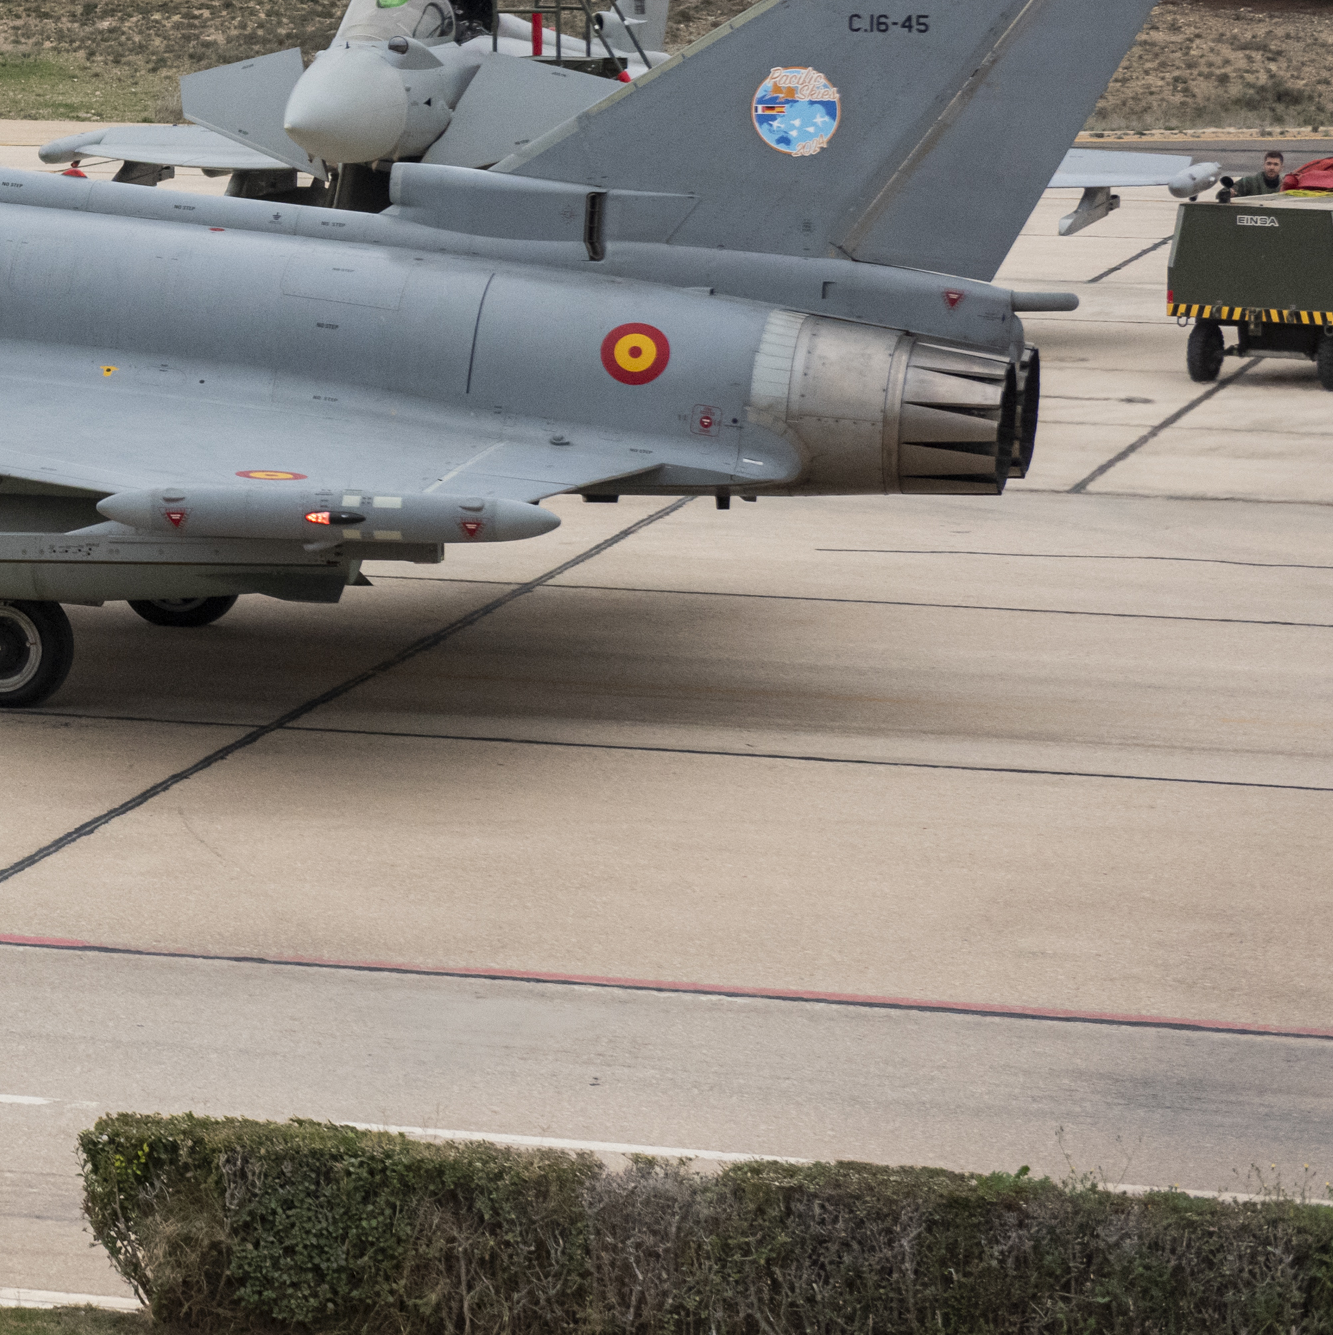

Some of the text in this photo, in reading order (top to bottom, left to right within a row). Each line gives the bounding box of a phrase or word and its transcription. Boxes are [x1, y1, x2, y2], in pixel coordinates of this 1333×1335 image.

[848, 14, 930, 33] C.16-45
[767, 67, 825, 86] Pacific
[795, 84, 839, 101] Skies
[792, 134, 828, 157] 2024
[1236, 215, 1279, 227] EINSA
